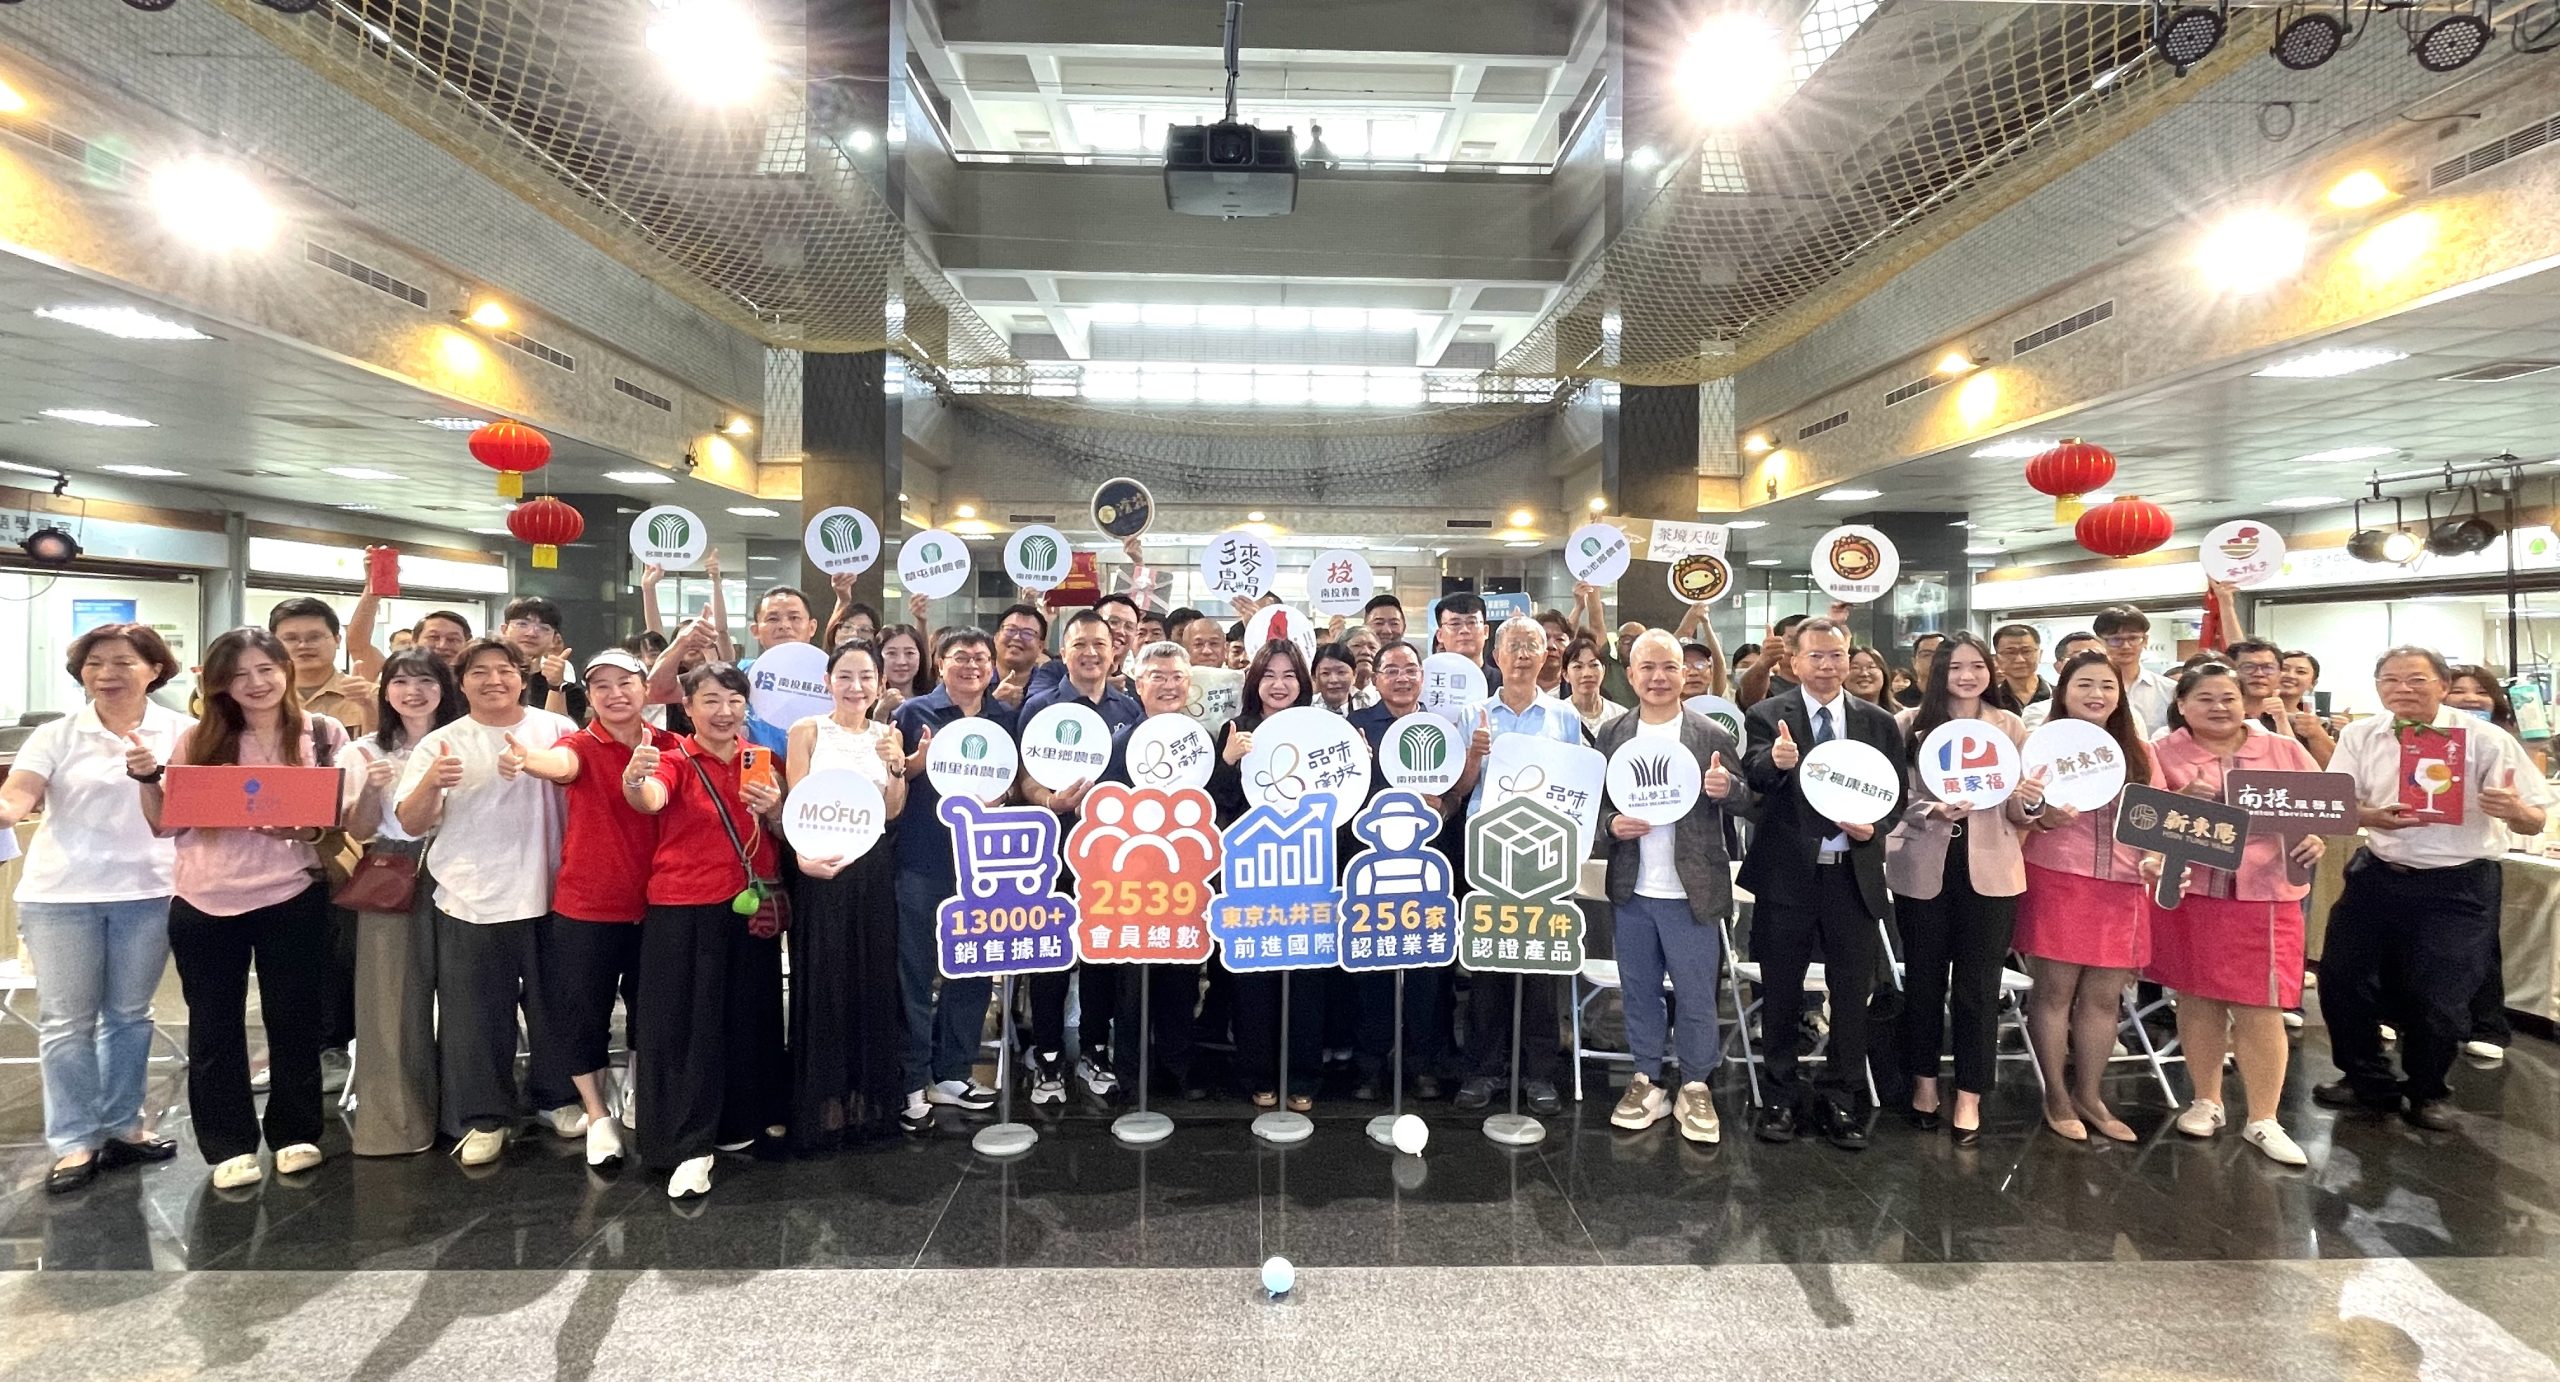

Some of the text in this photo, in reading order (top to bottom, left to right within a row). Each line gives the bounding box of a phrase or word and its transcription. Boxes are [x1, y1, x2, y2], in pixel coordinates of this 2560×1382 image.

[905, 559, 966, 581] 草屯鎮農會
[1208, 688, 1233, 701] 品味
[1026, 745, 1105, 765] 水里鄉農會
[1170, 731, 1199, 756] 品味
[1308, 740, 1351, 769] 品味
[932, 761, 1011, 780] 埔里鎮農會
[2056, 746, 2114, 775] 新東陽
[1396, 775, 1449, 784] 南投縣農會
[1829, 771, 1895, 802] 楓康超市
[1943, 773, 2005, 794] 萬家福
[1546, 784, 1588, 810] 品味
[2163, 809, 2238, 844] 新東陽
[2278, 810, 2315, 818] Service
[2319, 811, 2342, 819] Area
[1089, 880, 1197, 916] 2539
[951, 906, 1066, 936] 13000+
[1221, 902, 1339, 929] 東京丸井百
[1351, 900, 1447, 933] 256家
[1473, 904, 1572, 938] 557件
[954, 935, 1062, 964] 銷售據點
[1089, 924, 1201, 949] 會員總數
[1234, 932, 1336, 959] 前進國際
[1351, 932, 1448, 960] 認證業者
[1472, 937, 1572, 962] 認證產品
